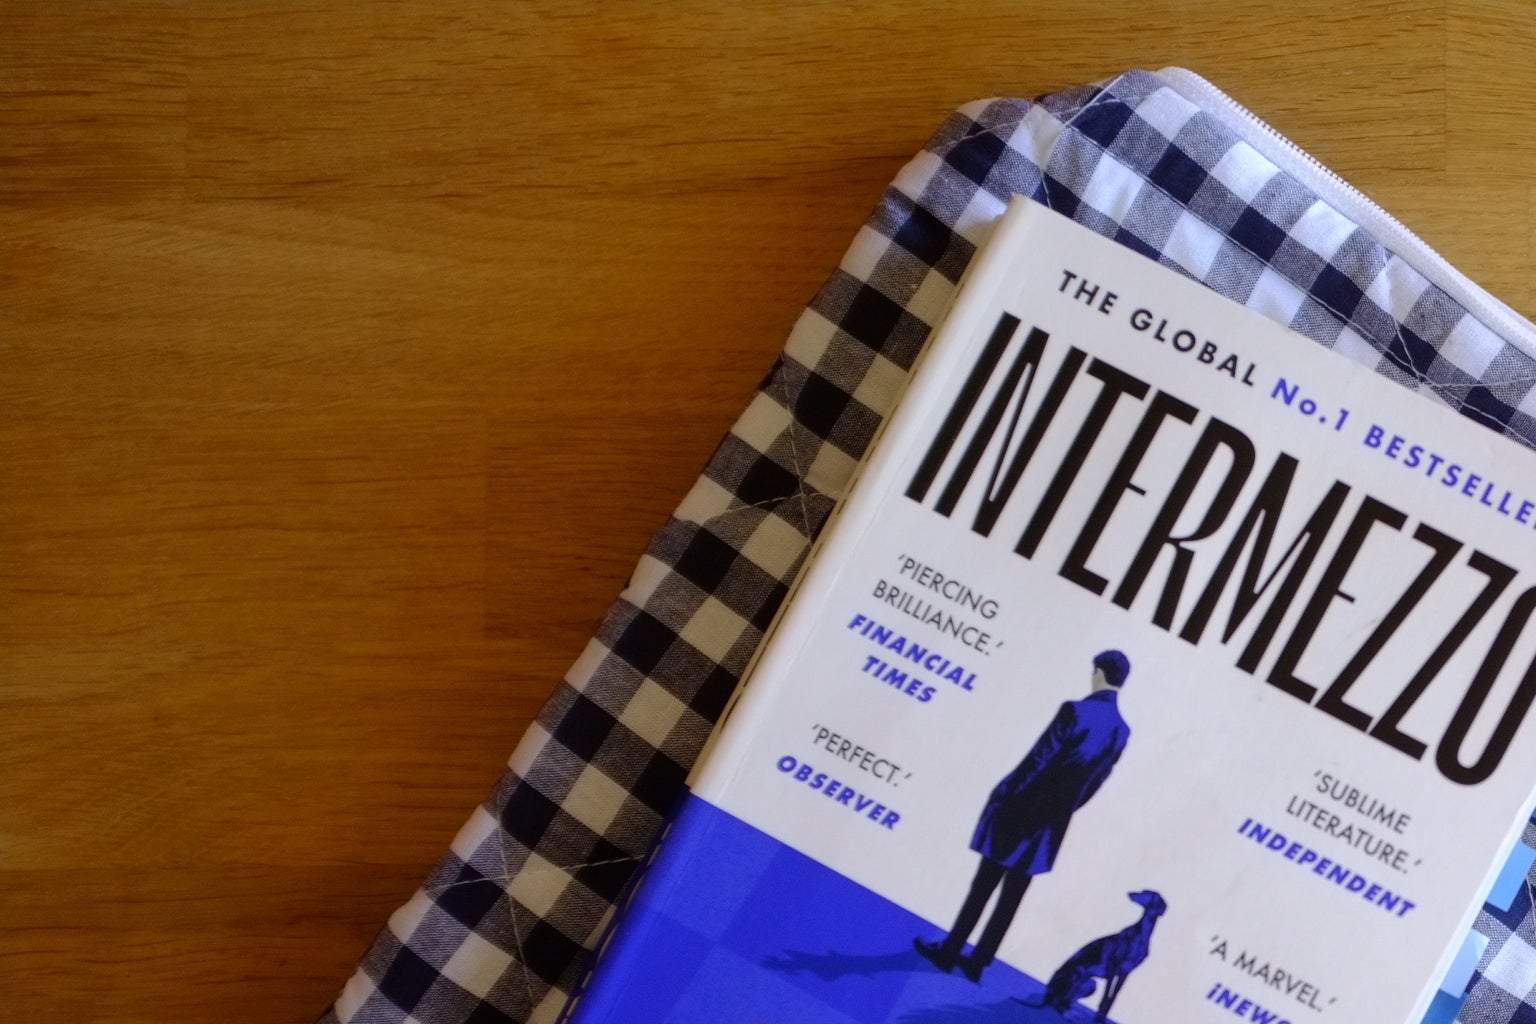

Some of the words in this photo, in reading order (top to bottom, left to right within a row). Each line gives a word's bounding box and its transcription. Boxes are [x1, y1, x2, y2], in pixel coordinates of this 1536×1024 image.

[1057, 269, 1118, 314] THE
[1130, 308, 1256, 386] GLOBAL
[1271, 378, 1350, 431] No.1
[847, 613, 977, 691] FINANCIAL
[861, 655, 937, 703] TIMES
[776, 755, 901, 830] OBSERVER
[1237, 818, 1415, 917] INDEPENDENT
